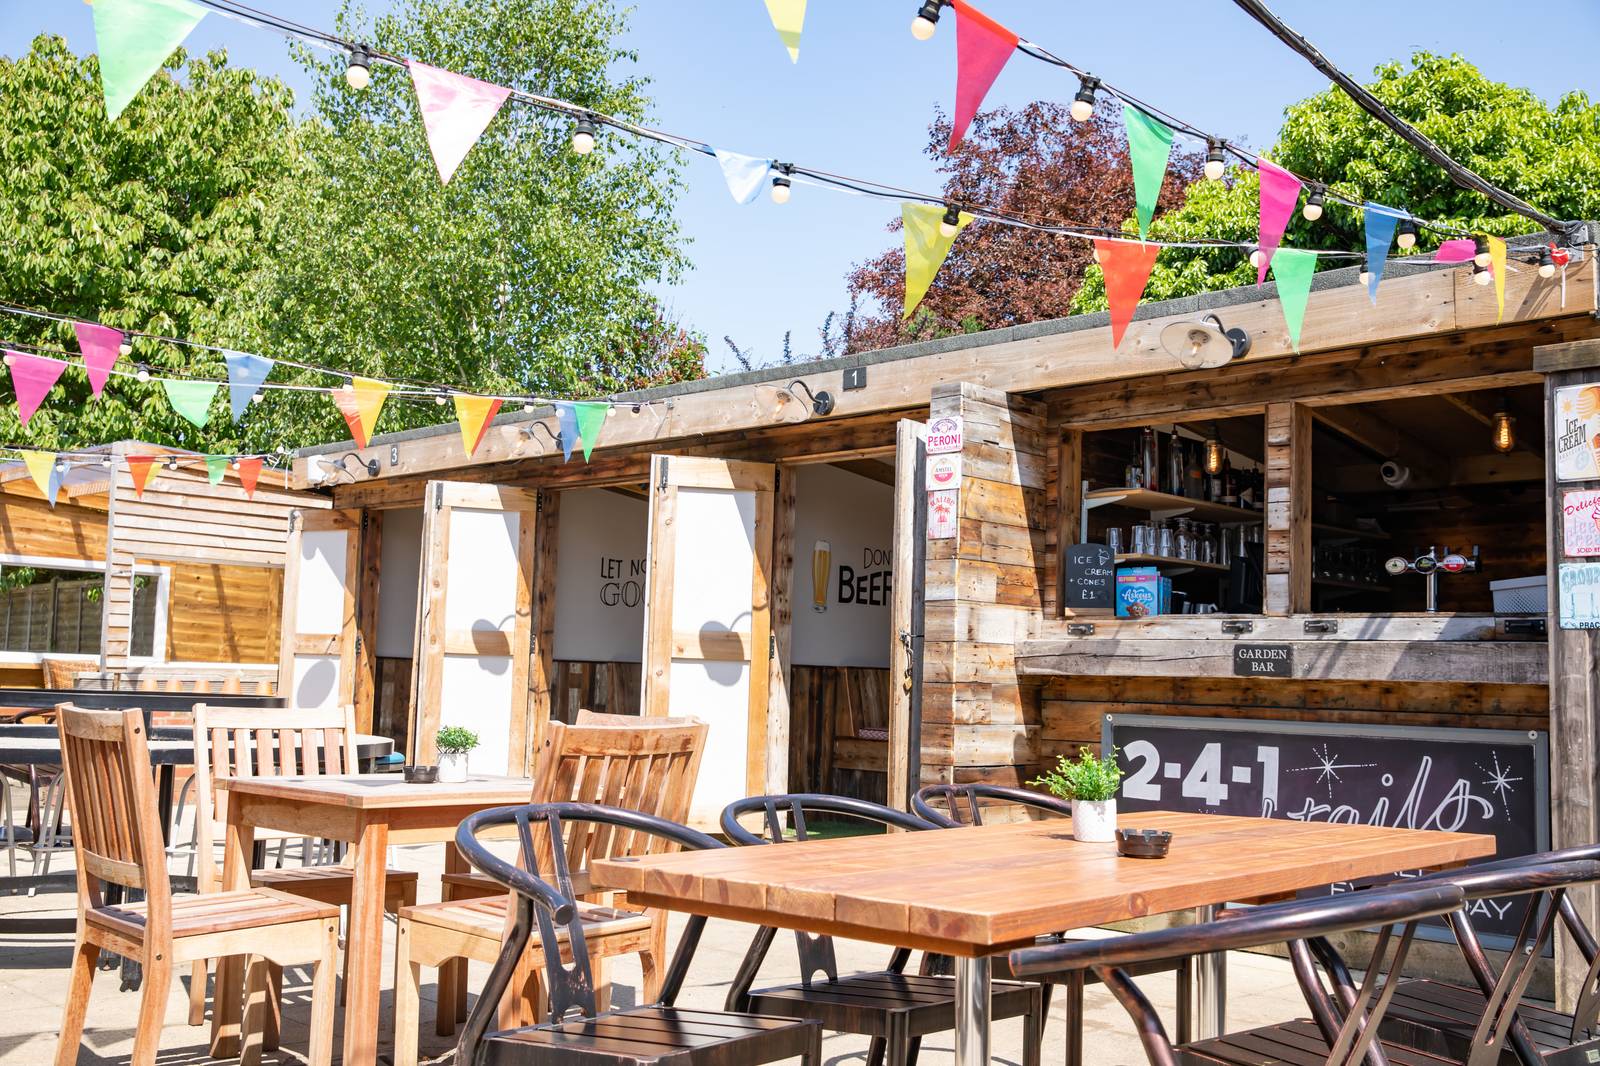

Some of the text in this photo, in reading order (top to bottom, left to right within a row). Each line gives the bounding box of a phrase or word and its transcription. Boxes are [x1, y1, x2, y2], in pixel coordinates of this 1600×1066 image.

[851, 370, 858, 386] 1
[1565, 418, 1579, 436] ICE
[927, 434, 961, 447] PERONI
[1558, 424, 1587, 453] CREAM
[391, 447, 398, 463] 3
[863, 547, 893, 569] DON
[1074, 556, 1093, 564] ICE
[600, 557, 623, 579] LET
[1084, 568, 1113, 576] CREAM
[1077, 578, 1106, 586] CONES
[600, 580, 646, 607] GO
[1081, 588, 1096, 600] £1
[1238, 648, 1288, 660] GARDEN
[1251, 661, 1275, 672] BAR
[1122, 739, 1280, 812] 2-4-1
